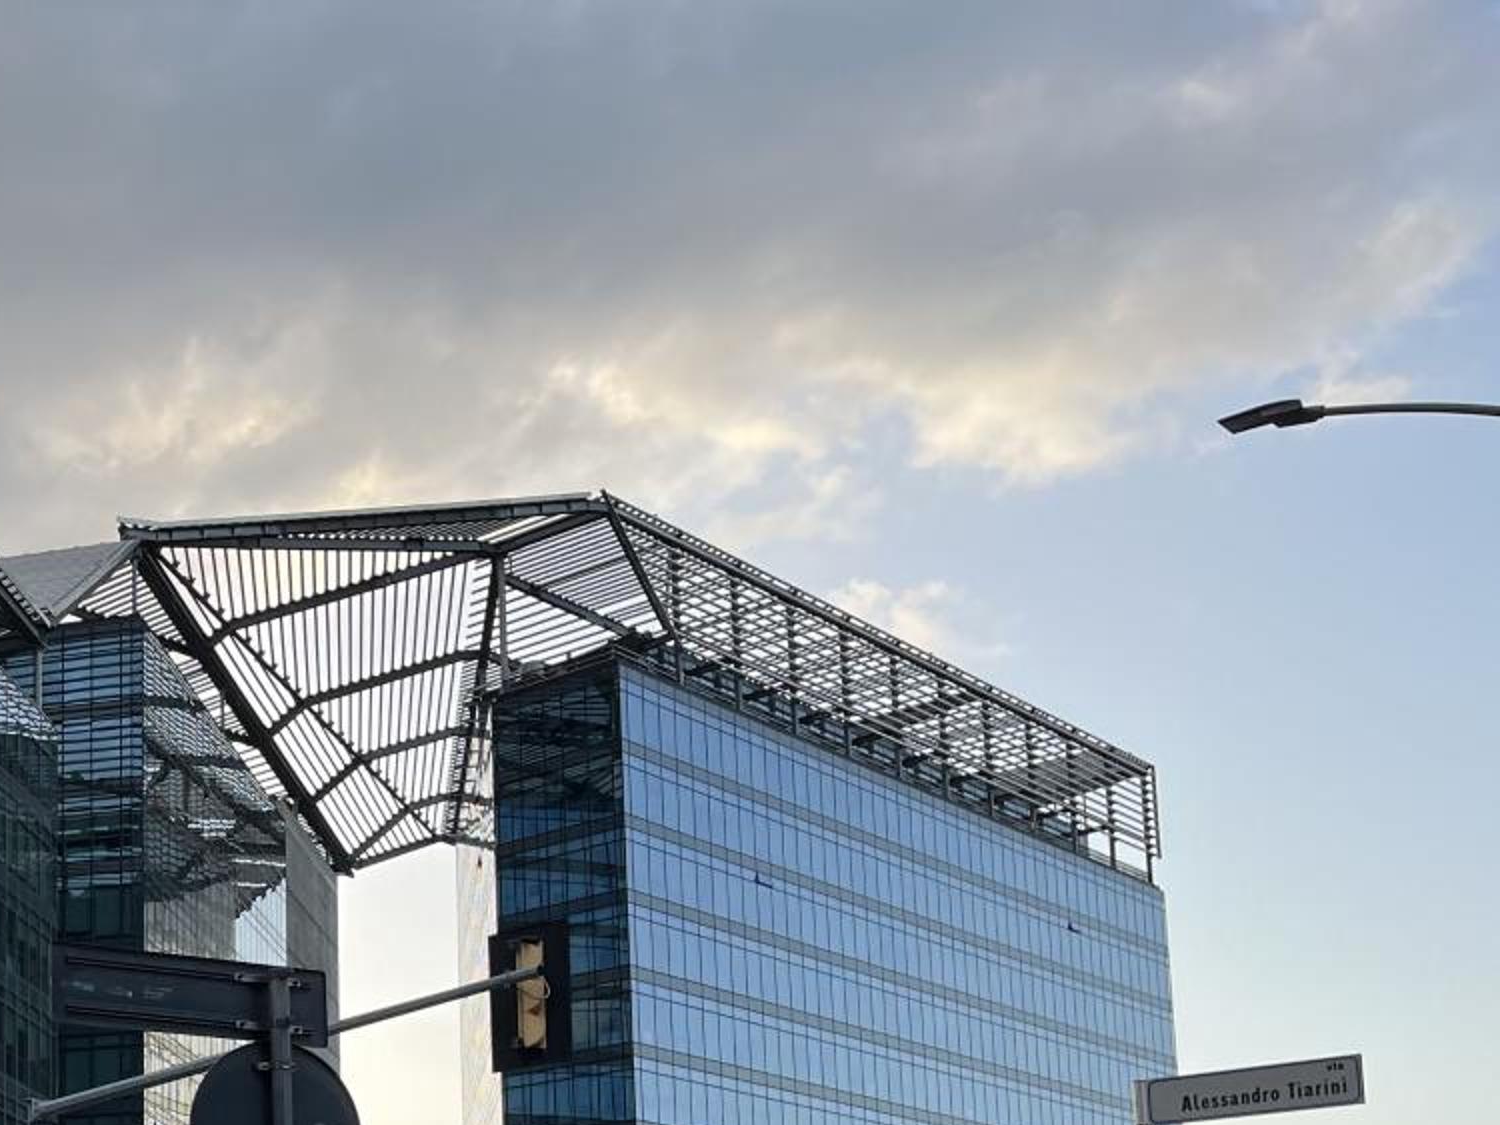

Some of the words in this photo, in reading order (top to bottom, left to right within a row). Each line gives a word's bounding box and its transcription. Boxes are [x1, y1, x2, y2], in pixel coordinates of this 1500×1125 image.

[1326, 1062, 1345, 1073] via
[1180, 1087, 1280, 1114] Alessandro
[1287, 1076, 1349, 1100] Tiarini
